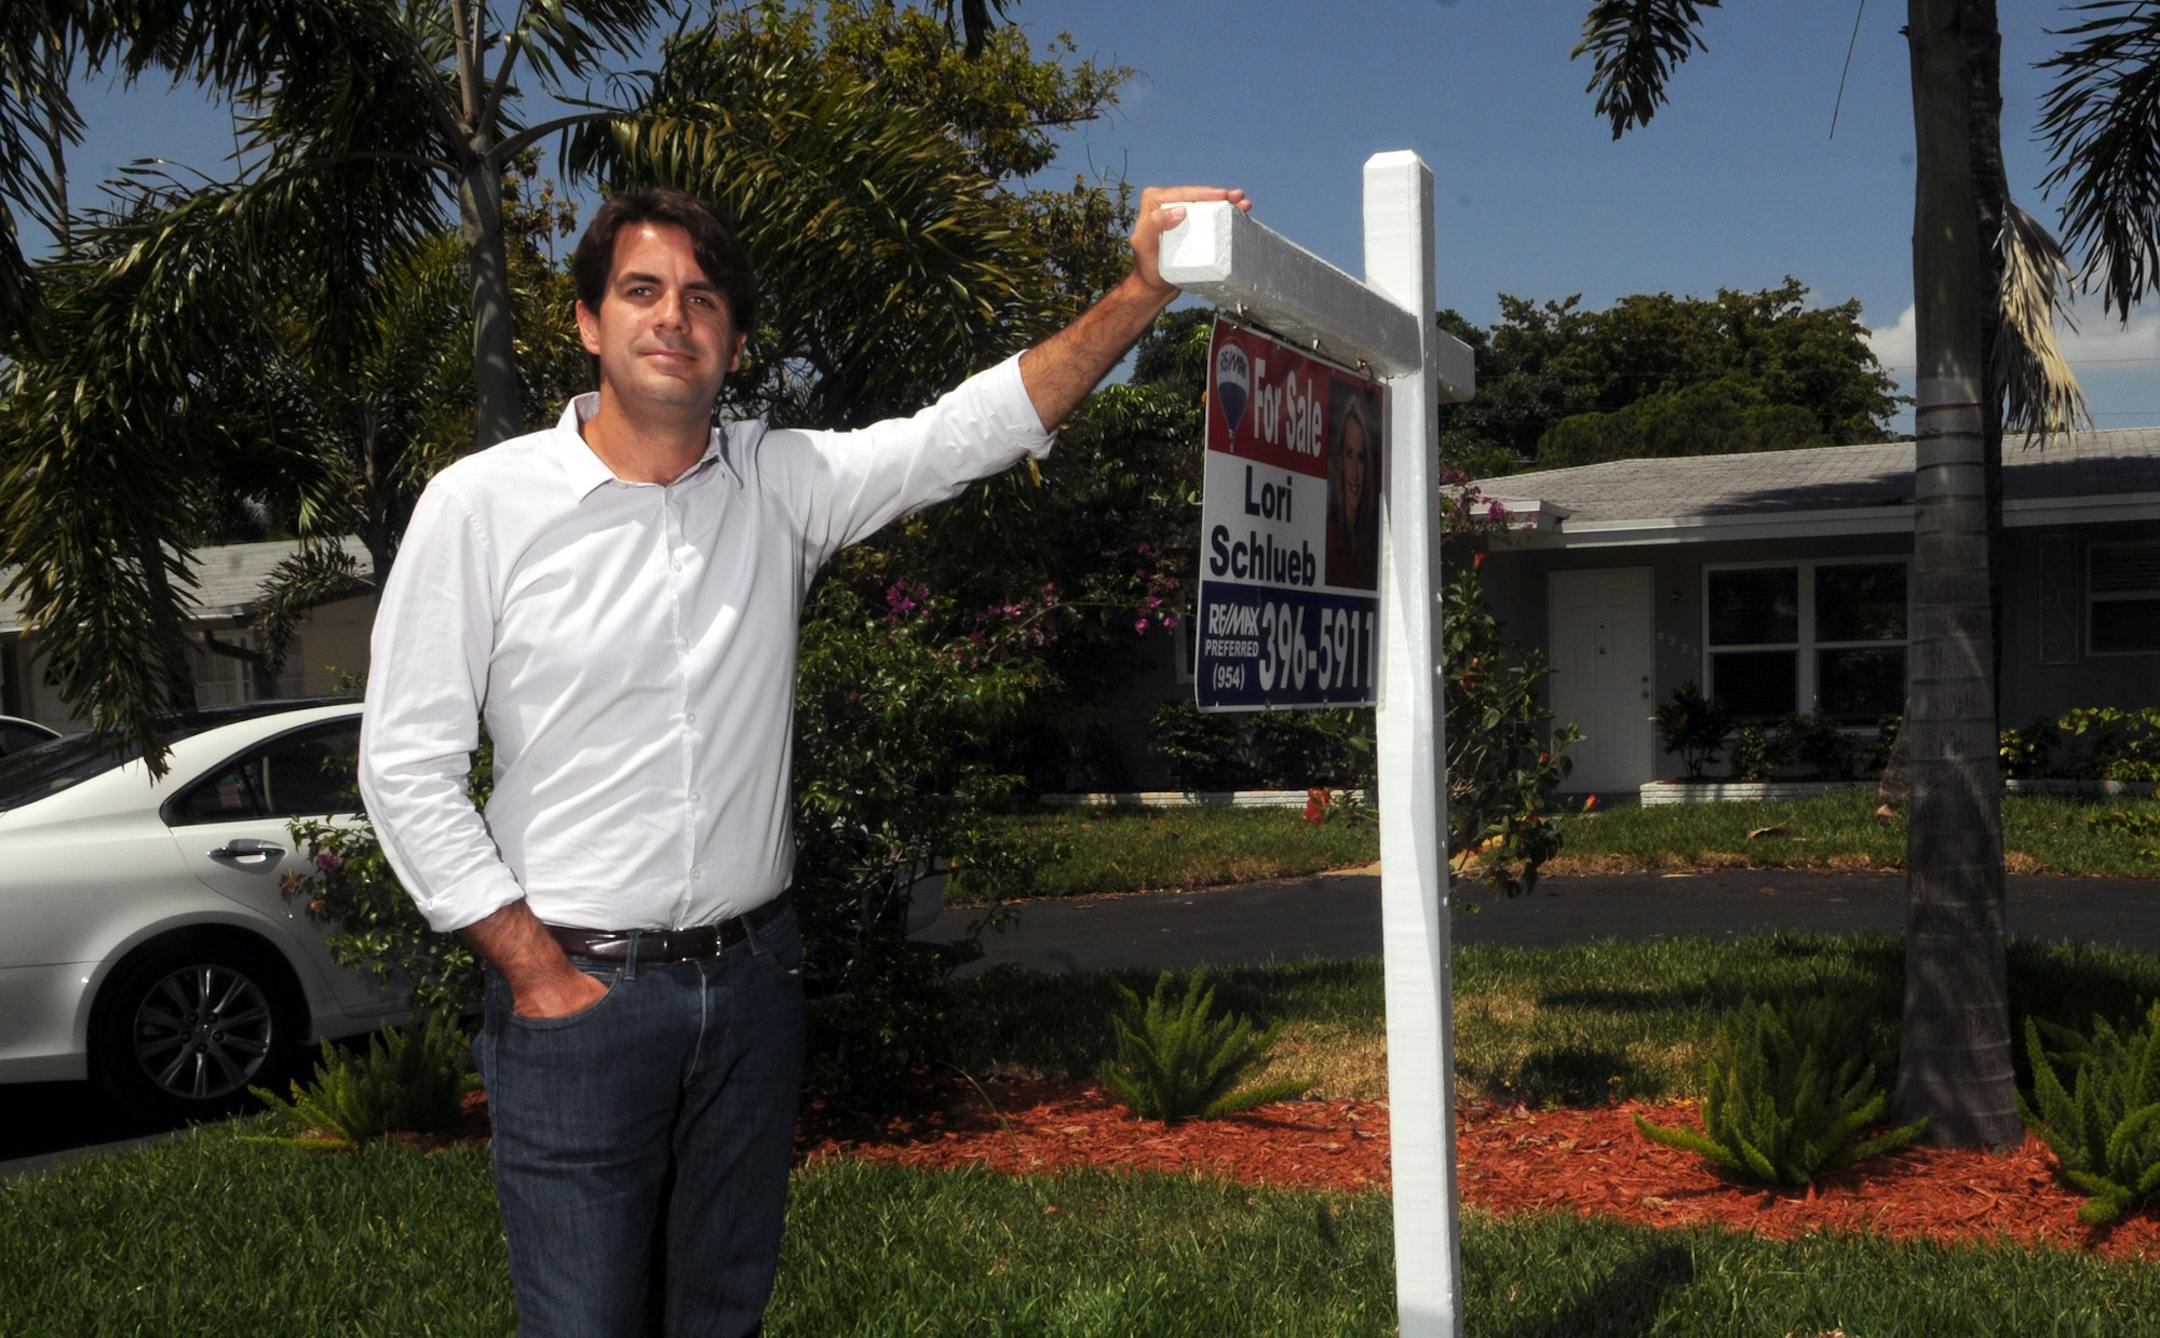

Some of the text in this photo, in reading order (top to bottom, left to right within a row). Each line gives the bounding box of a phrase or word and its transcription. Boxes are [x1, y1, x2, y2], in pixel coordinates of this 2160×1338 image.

[1254, 357, 1323, 458] For Sale
[1244, 465, 1292, 523] Lori
[1209, 525, 1316, 587] Schlueb
[1205, 639, 1259, 657] PREFERRED
[1208, 603, 1260, 637] RE/MAX
[1259, 601, 1375, 691] 396-5911
[1213, 663, 1245, 691] (954)
